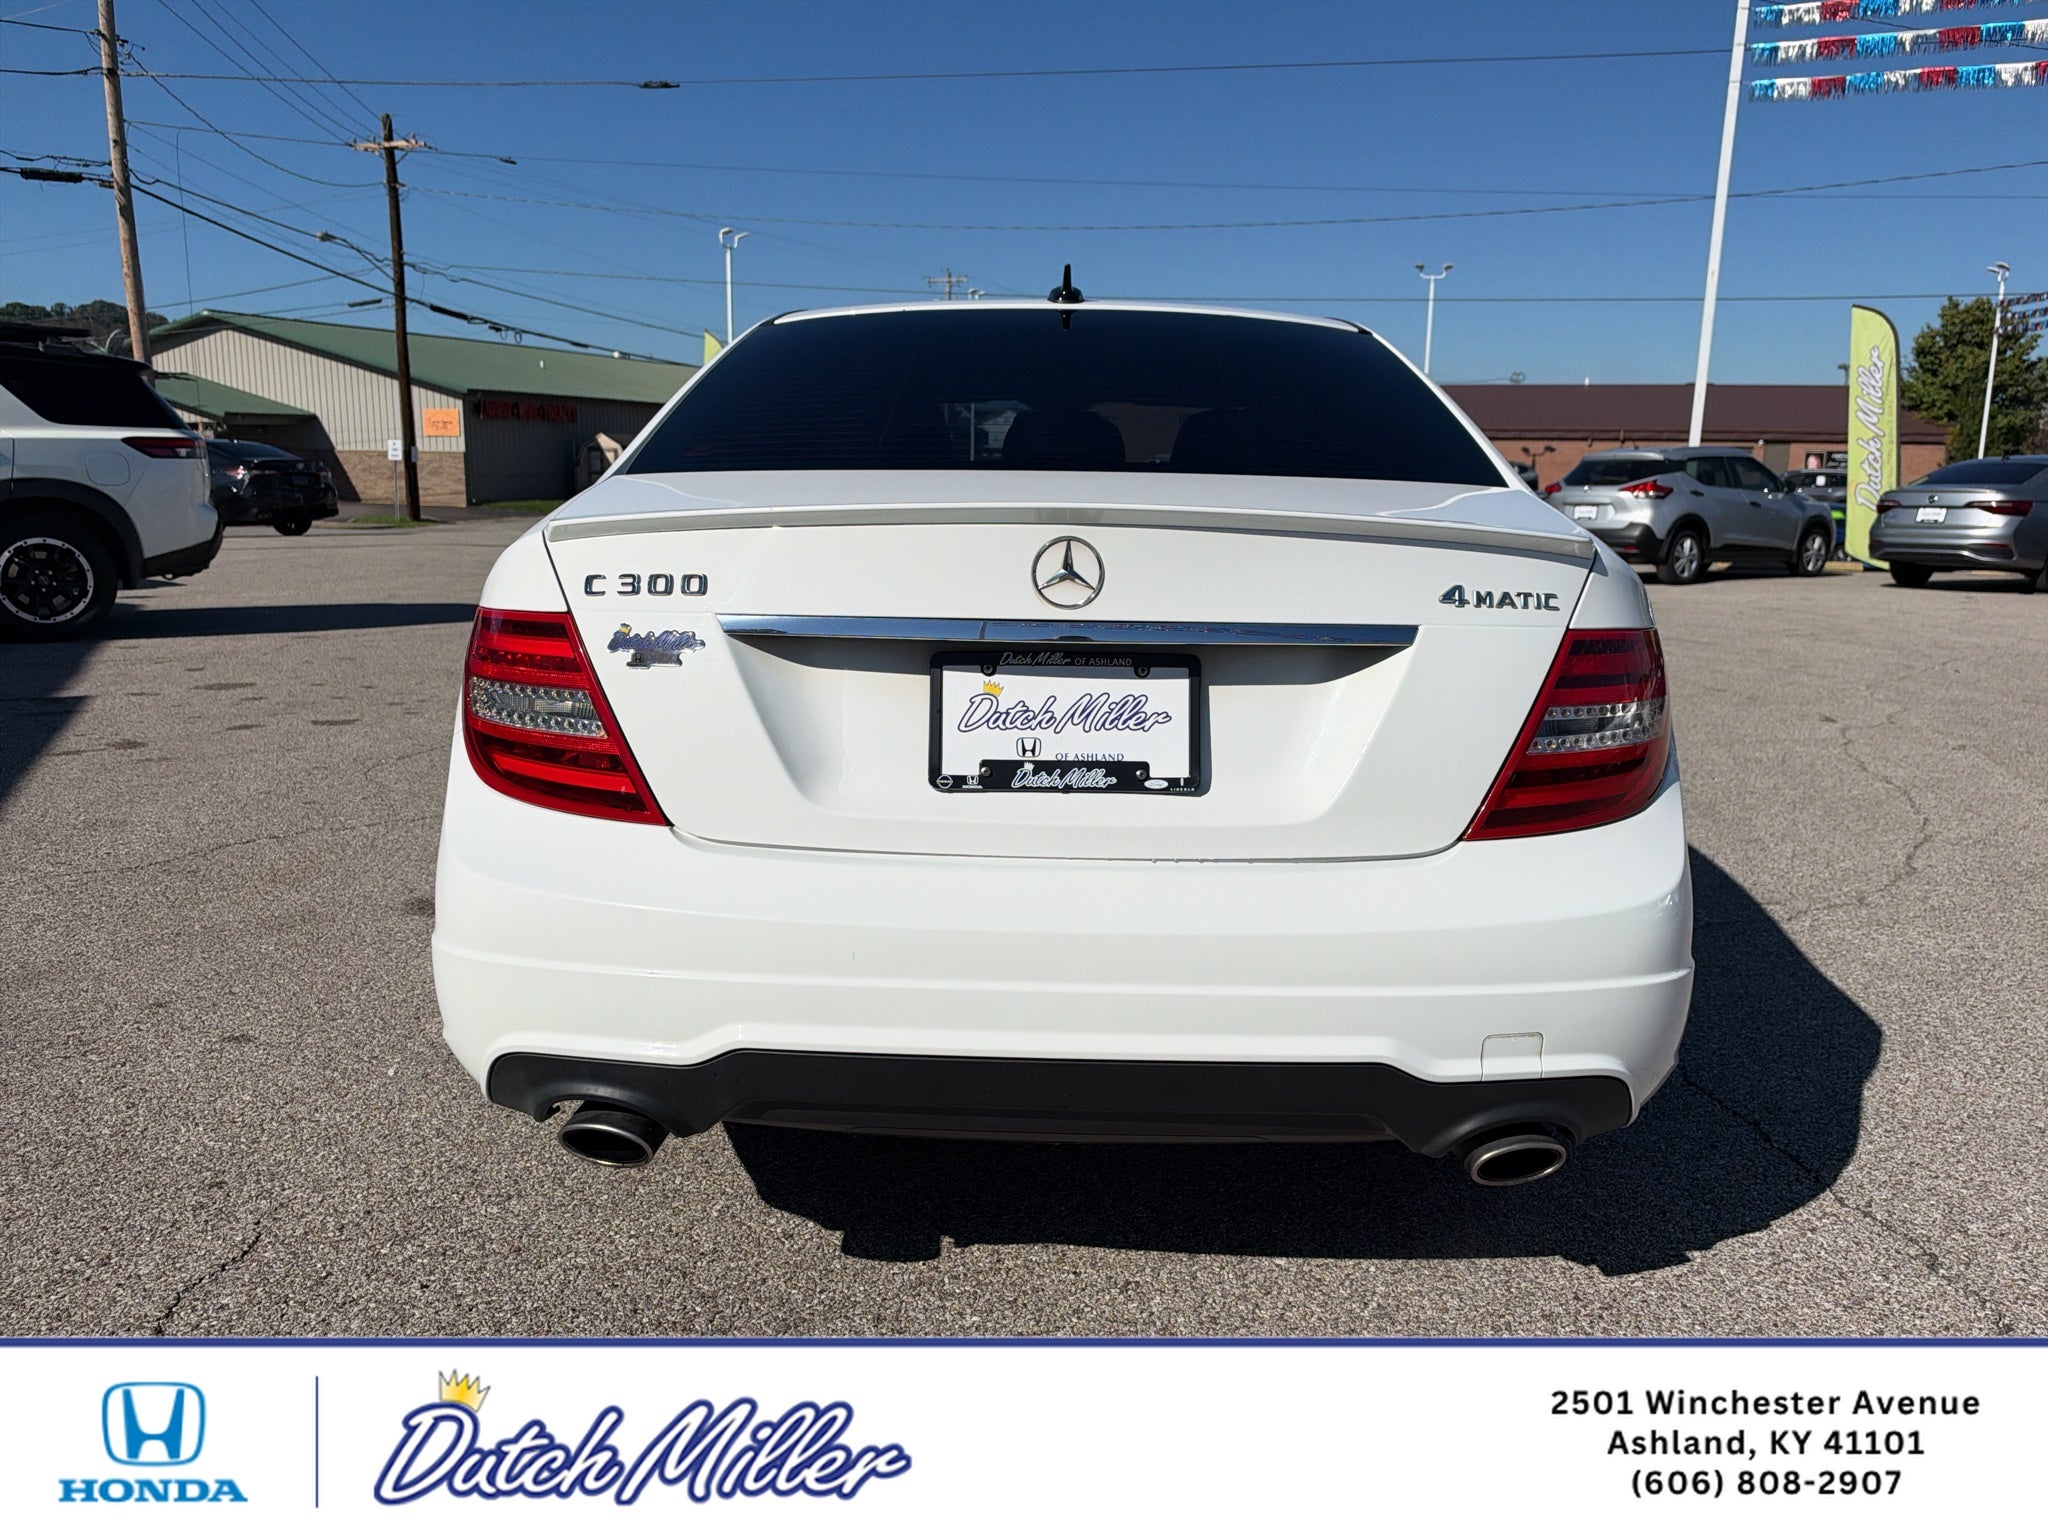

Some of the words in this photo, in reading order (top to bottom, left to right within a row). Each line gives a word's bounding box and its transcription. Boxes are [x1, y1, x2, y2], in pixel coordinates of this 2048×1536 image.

[1855, 346, 1885, 438] Miller
[1854, 437, 1883, 512] Dutch
[584, 574, 607, 597] C
[616, 573, 709, 597] 300
[1439, 584, 1561, 612] 4MATIC
[999, 652, 1033, 666] Dutch
[1031, 651, 1072, 666] Miller
[1074, 657, 1088, 666] OF
[1088, 657, 1133, 667] ASHLAND
[957, 692, 1057, 733] Dutch
[1054, 692, 1172, 734] Miller
[1055, 752, 1069, 761] OF
[1070, 752, 1125, 761] ASHLAND
[1011, 767, 1061, 788] Dutch
[1058, 767, 1118, 789] Miller
